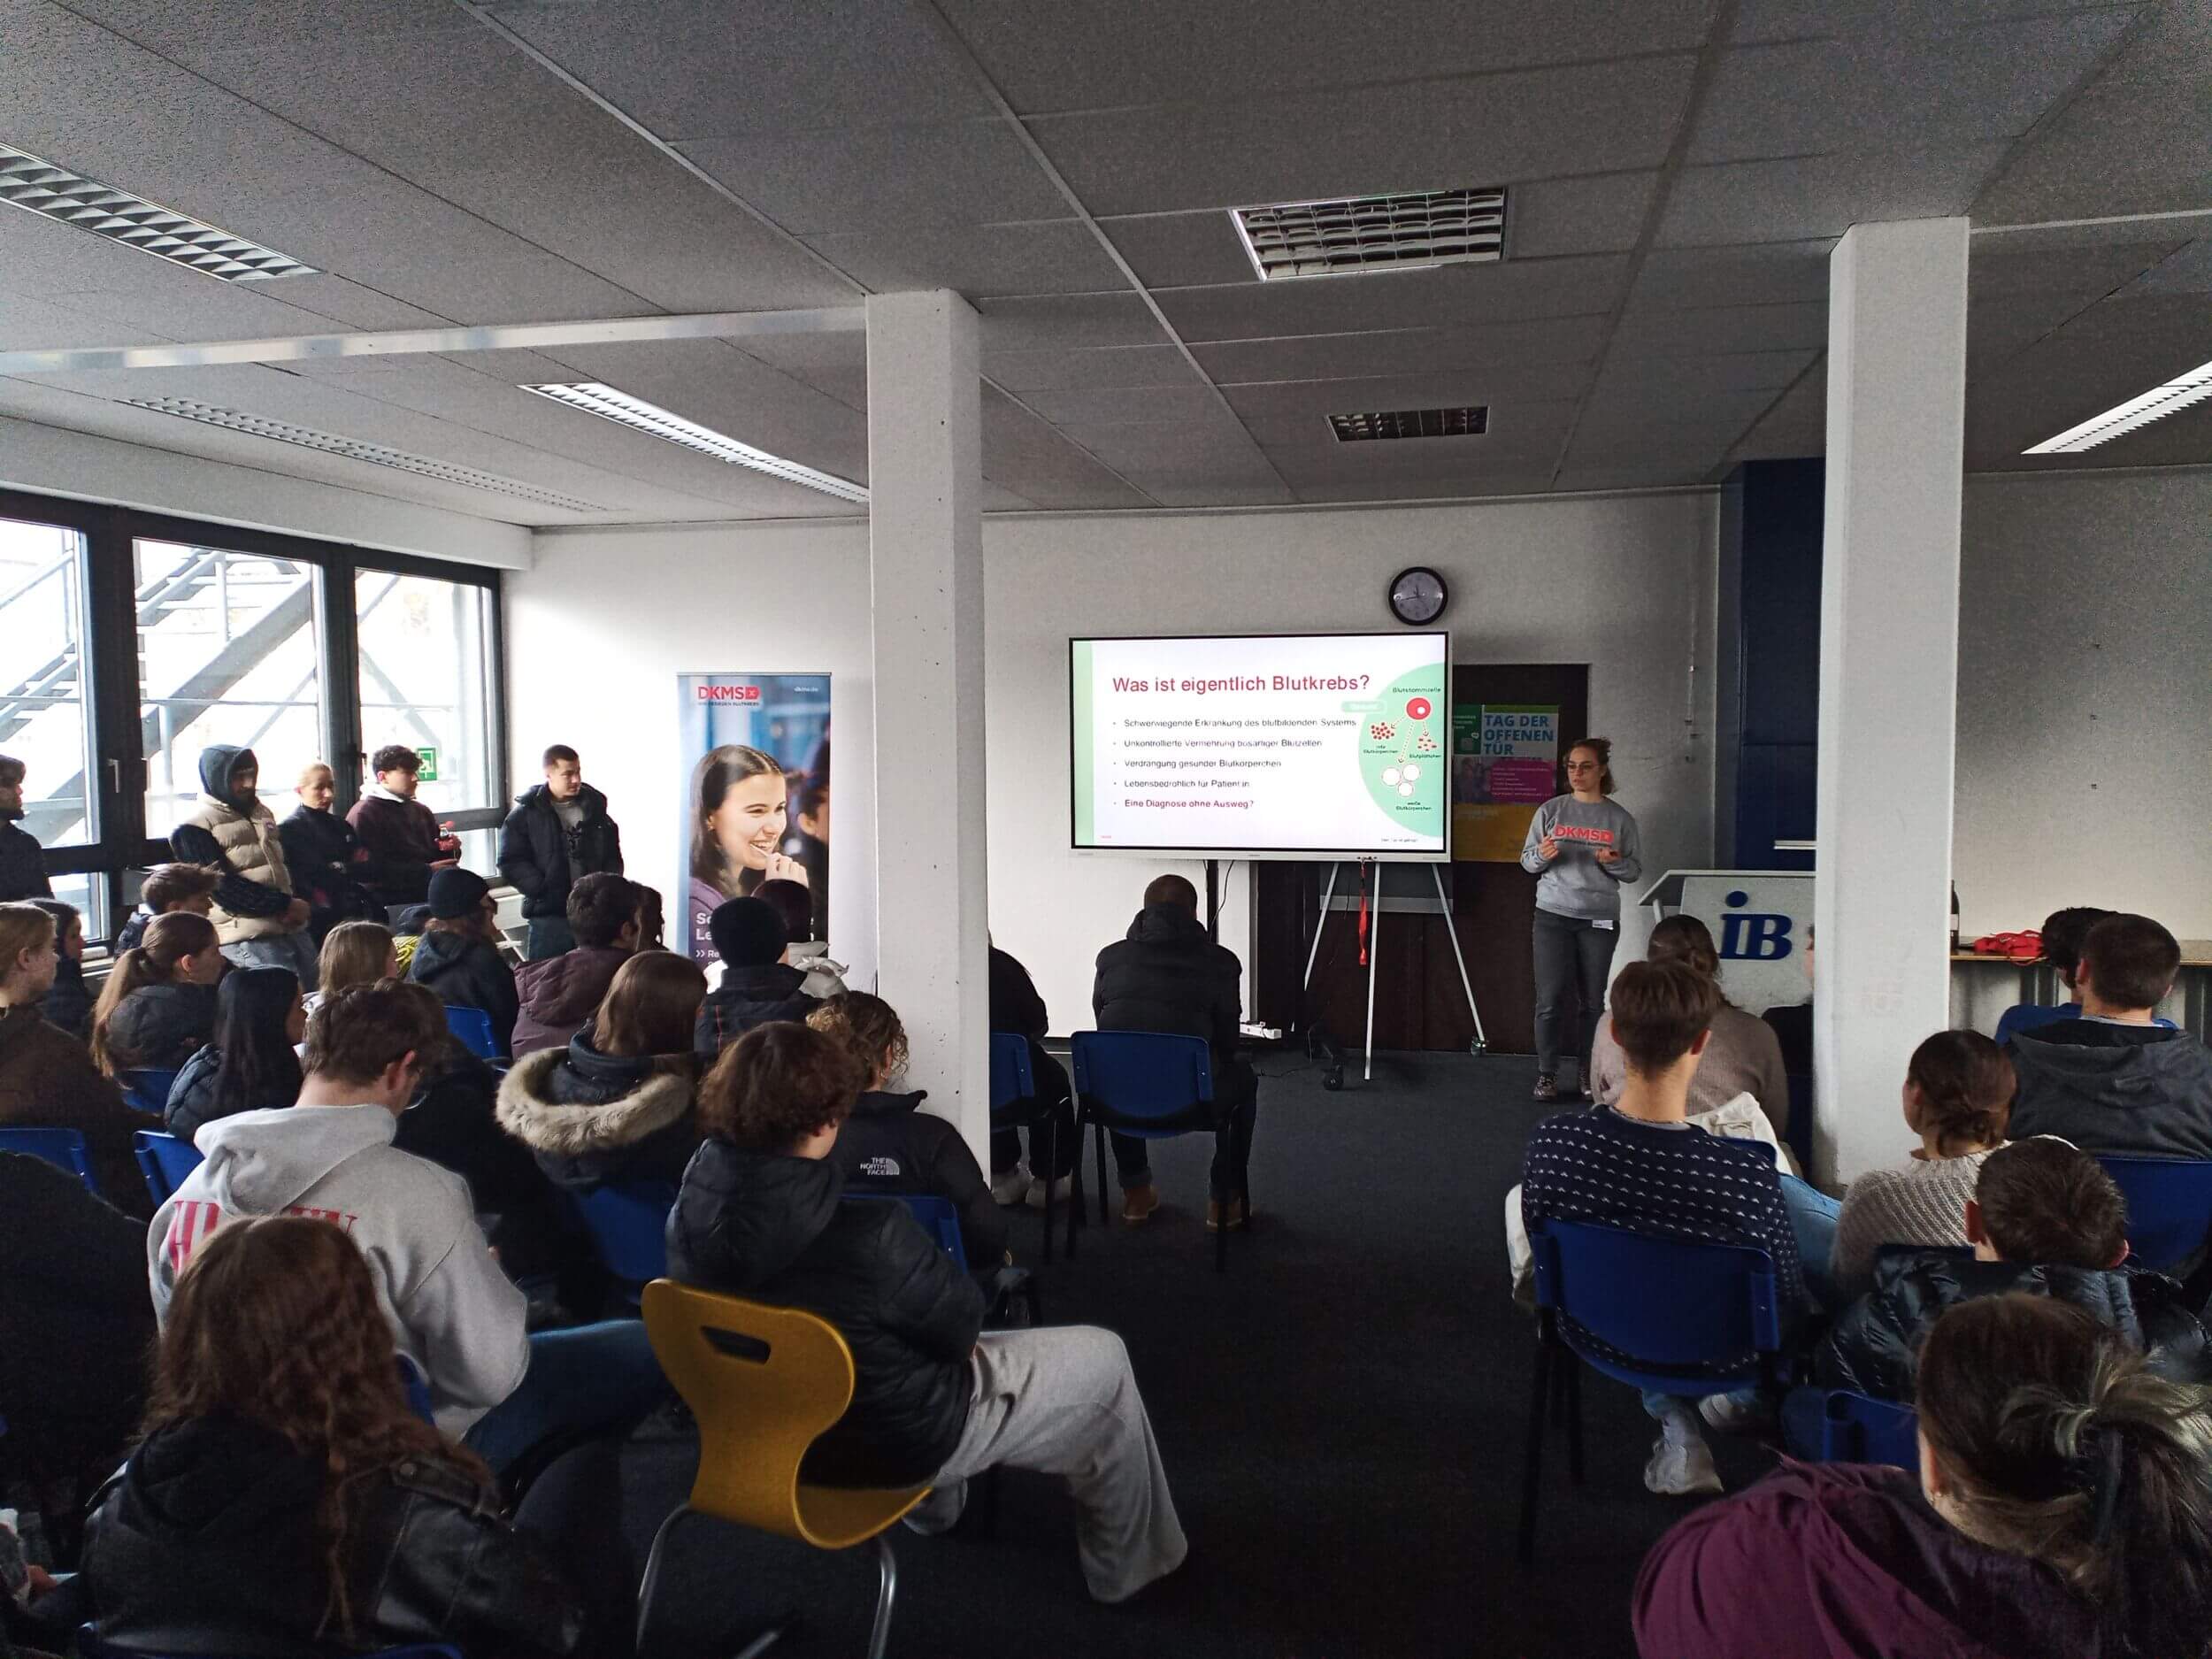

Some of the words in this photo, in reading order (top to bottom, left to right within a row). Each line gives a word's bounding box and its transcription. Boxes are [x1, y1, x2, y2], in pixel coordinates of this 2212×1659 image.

[1112, 677, 1148, 692] Was
[1155, 676, 1176, 691] ist
[1181, 675, 1265, 695] eigentlich
[1272, 674, 1371, 691] Blutkrebs?
[697, 686, 744, 700] DKMS
[1124, 718, 1193, 729] Schwerwiegende
[1194, 718, 1242, 728] Erkrankung
[1320, 718, 1357, 727] Systems
[1485, 714, 1515, 727] TAG
[1519, 715, 1549, 727] DER
[1484, 728, 1554, 741] OFFENEN
[1124, 739, 1182, 748] Unkontrollierte
[1185, 739, 1235, 749] Vermehrung
[1280, 738, 1323, 748] Blutzellen
[1483, 741, 1514, 756] TÜR
[1179, 759, 1217, 769] gesunder
[1124, 799, 1144, 808] Eine
[1145, 799, 1187, 809] Diagnose
[1188, 799, 1211, 808] ohne
[1213, 799, 1255, 810] Ausweg?
[1554, 824, 1601, 841] DKMS
